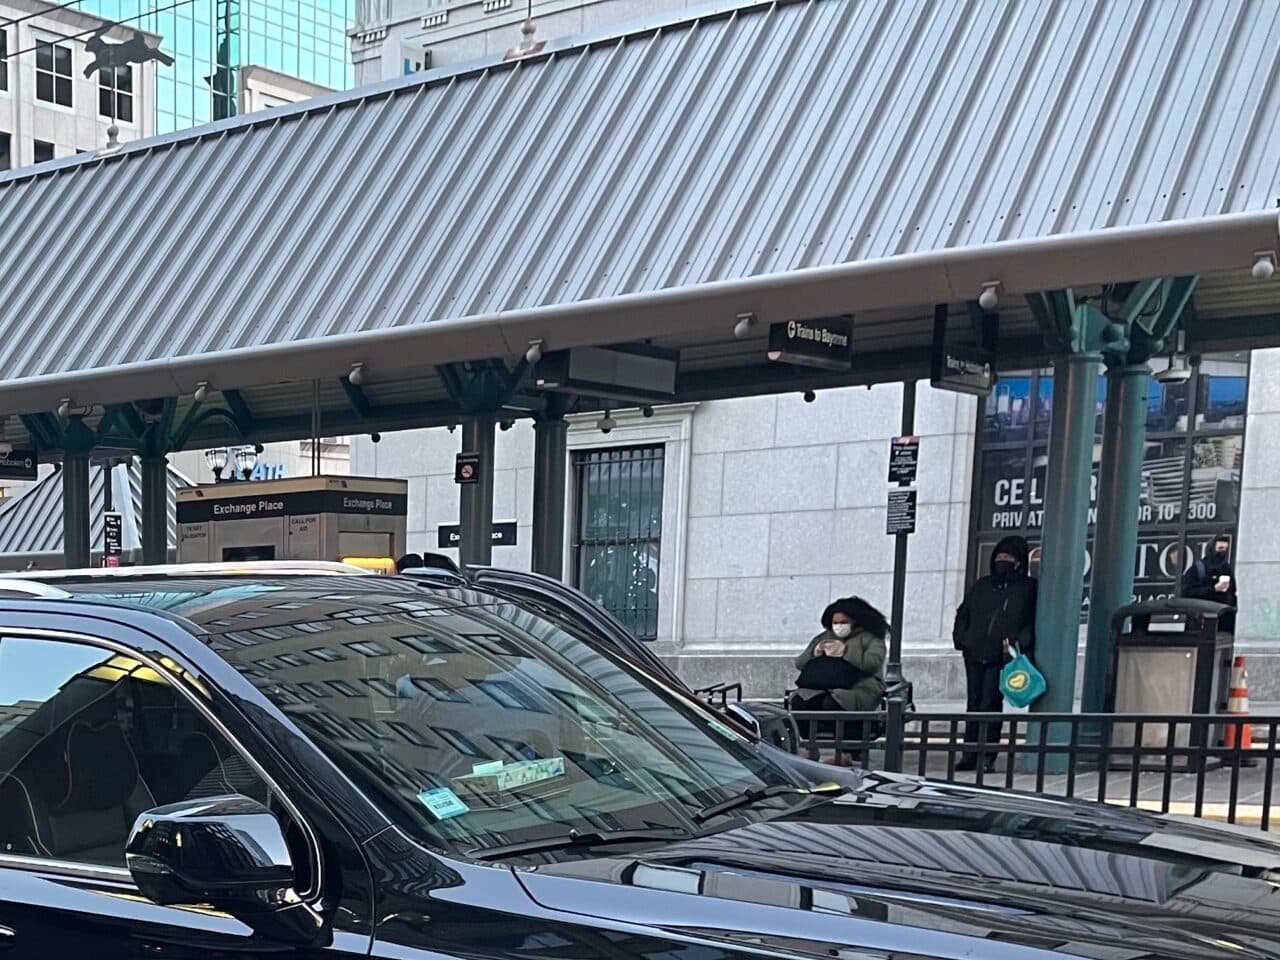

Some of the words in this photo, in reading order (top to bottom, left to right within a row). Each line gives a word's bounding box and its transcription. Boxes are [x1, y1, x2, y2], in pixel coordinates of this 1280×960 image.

[796, 323, 814, 340] Trains
[814, 328, 822, 342] to
[822, 328, 848, 347] Bayonne
[213, 503, 257, 515] Exchange
[258, 500, 284, 511] Place
[343, 497, 374, 511] Exchange
[375, 498, 393, 510] Place
[991, 510, 1045, 528] PRIVAT
